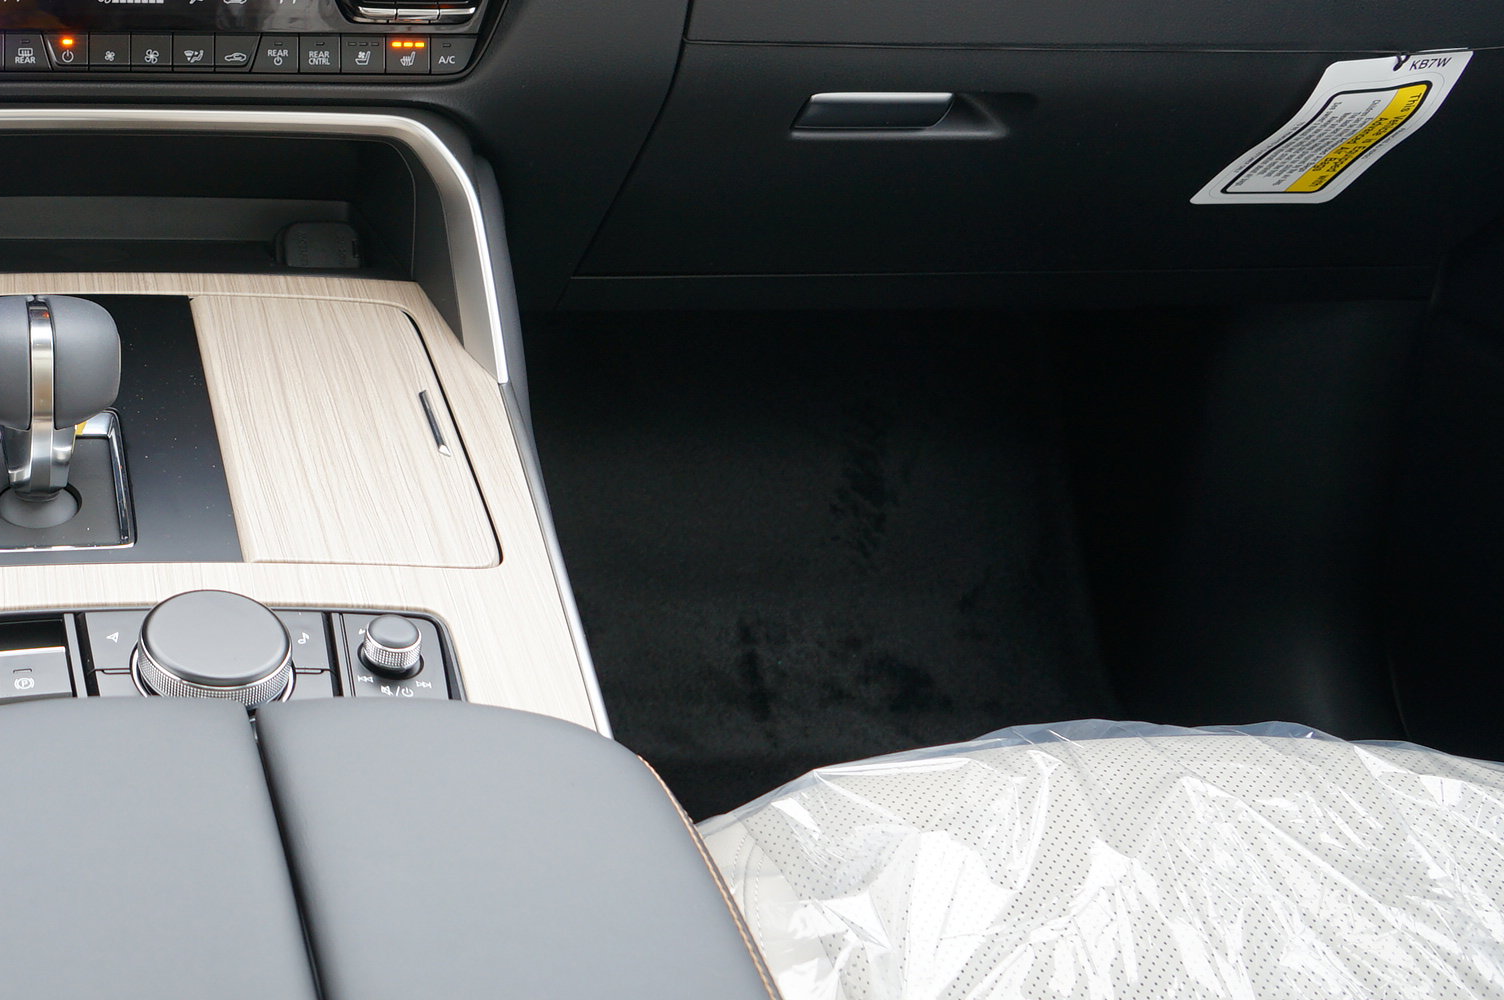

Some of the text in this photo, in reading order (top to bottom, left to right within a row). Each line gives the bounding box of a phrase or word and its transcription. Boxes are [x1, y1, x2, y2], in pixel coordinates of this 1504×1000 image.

[267, 48, 289, 58] REAR
[14, 55, 37, 65] REAR
[308, 57, 331, 65] CNTRL
[438, 55, 456, 65] A/C
[1410, 57, 1452, 71] KB7W
